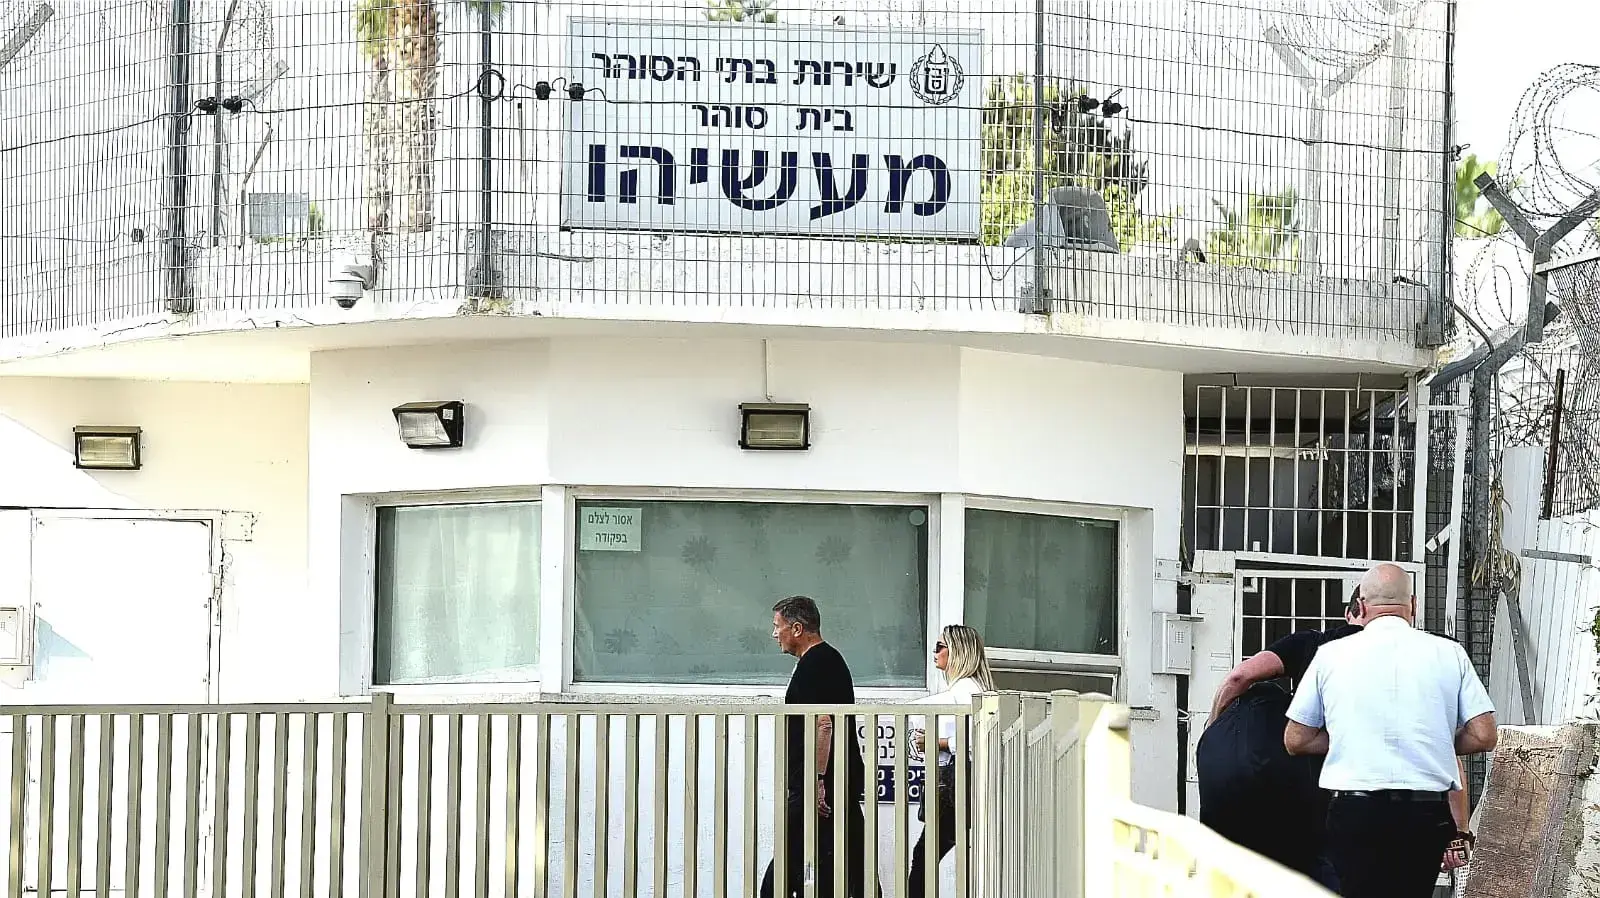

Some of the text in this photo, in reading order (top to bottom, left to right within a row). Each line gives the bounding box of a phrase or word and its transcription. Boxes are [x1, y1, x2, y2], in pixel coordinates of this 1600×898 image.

[591, 52, 896, 88] שירות בתי הסוהר
[692, 104, 854, 131] בית סוהר
[587, 143, 952, 221] מעשיהו
[588, 511, 632, 524] אסור לצלם
[595, 533, 627, 545] בפקודה
